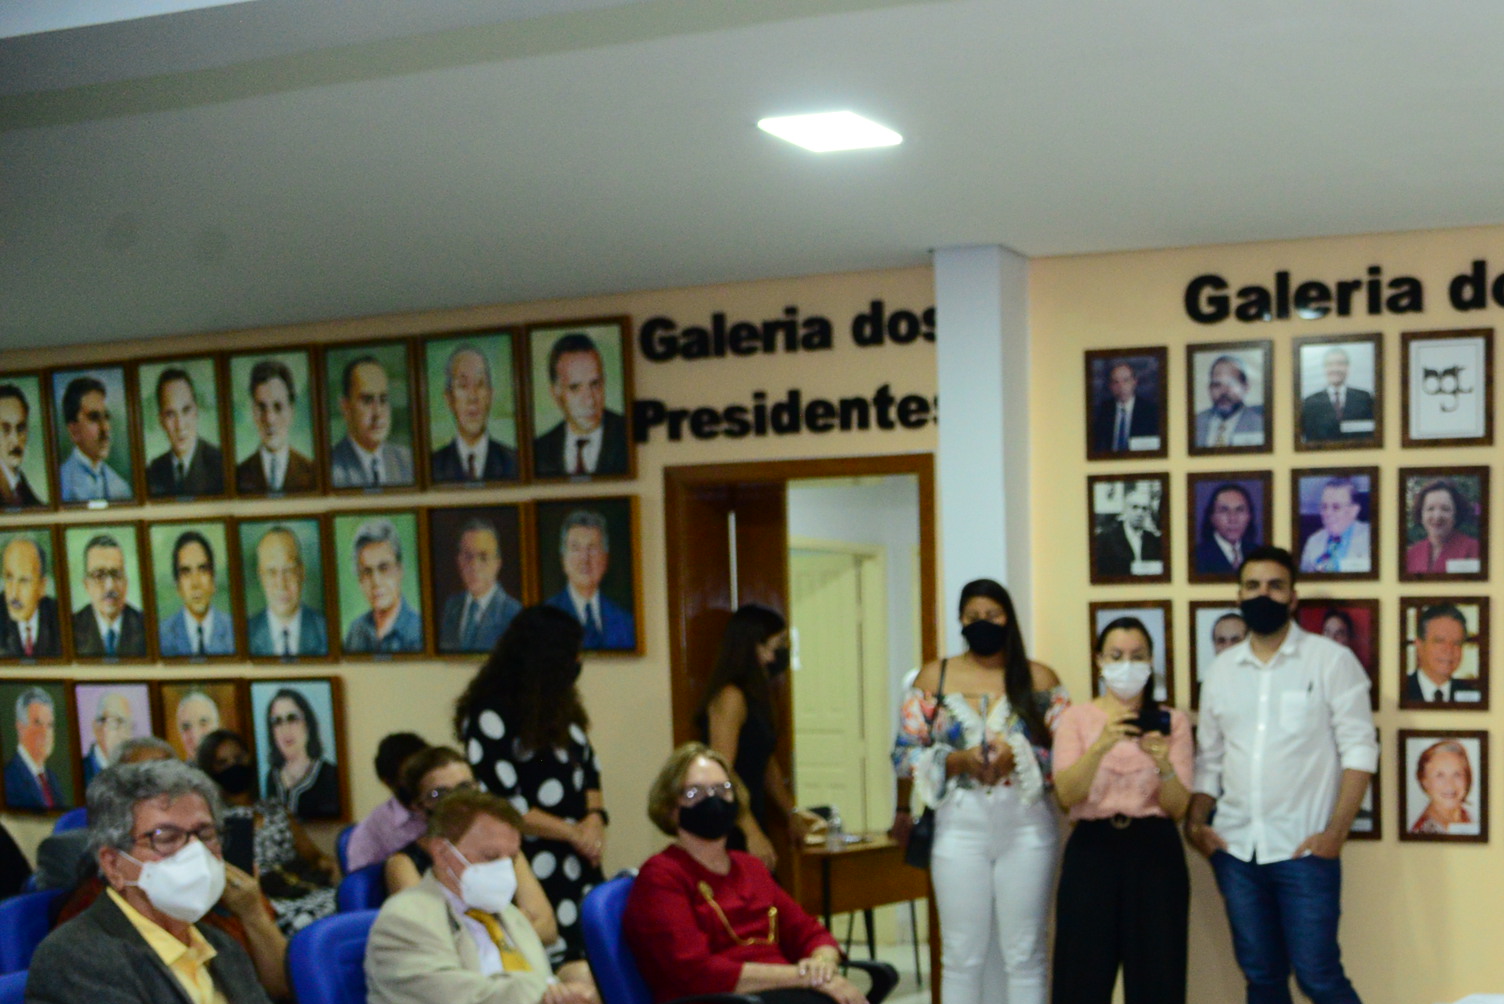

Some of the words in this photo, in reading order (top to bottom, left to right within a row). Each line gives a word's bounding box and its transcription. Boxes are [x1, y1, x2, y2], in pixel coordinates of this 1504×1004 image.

[1184, 265, 1424, 325] Galeria
[640, 306, 833, 362] Galeria
[633, 383, 937, 443] Presidente
